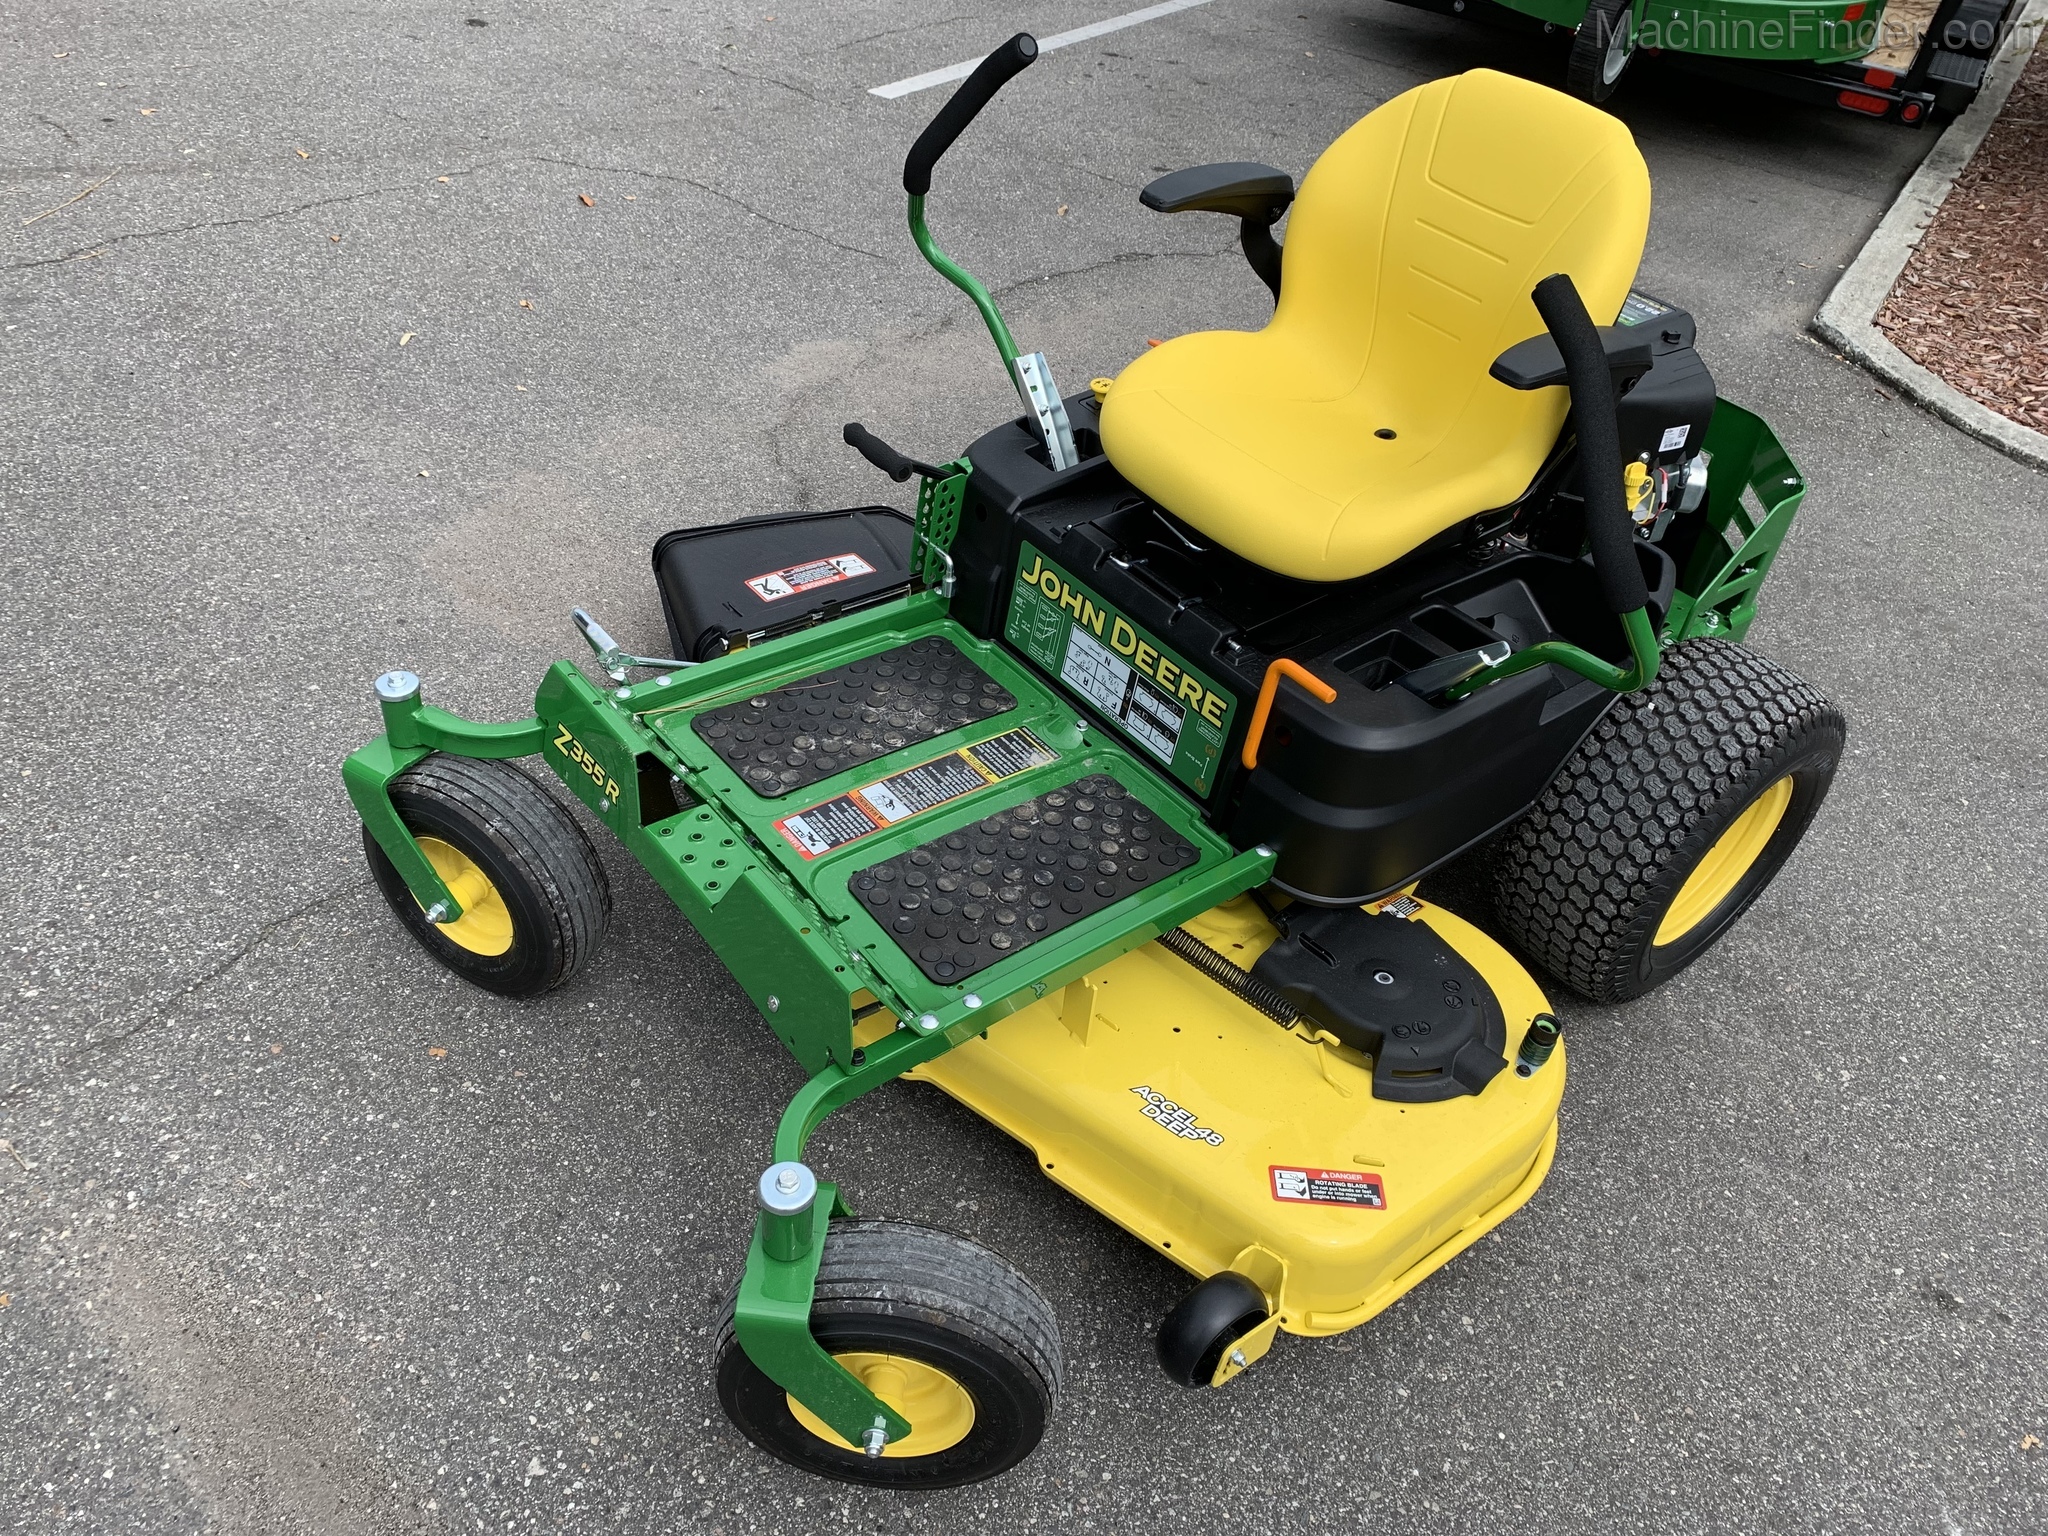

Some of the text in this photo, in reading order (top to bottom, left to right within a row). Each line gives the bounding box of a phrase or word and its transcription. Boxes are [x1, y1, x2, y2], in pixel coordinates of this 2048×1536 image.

[1021, 554, 1228, 728] JOHN DEERE
[1104, 656, 1112, 667] N
[1083, 676, 1090, 687] R
[1110, 701, 1118, 710] F
[1100, 703, 1129, 731] OPERATION
[855, 795, 880, 817] WARNING
[1129, 1085, 1198, 1130] ACCEL
[1139, 1103, 1225, 1147] DEEP 48
[1329, 1172, 1363, 1181] DANGER
